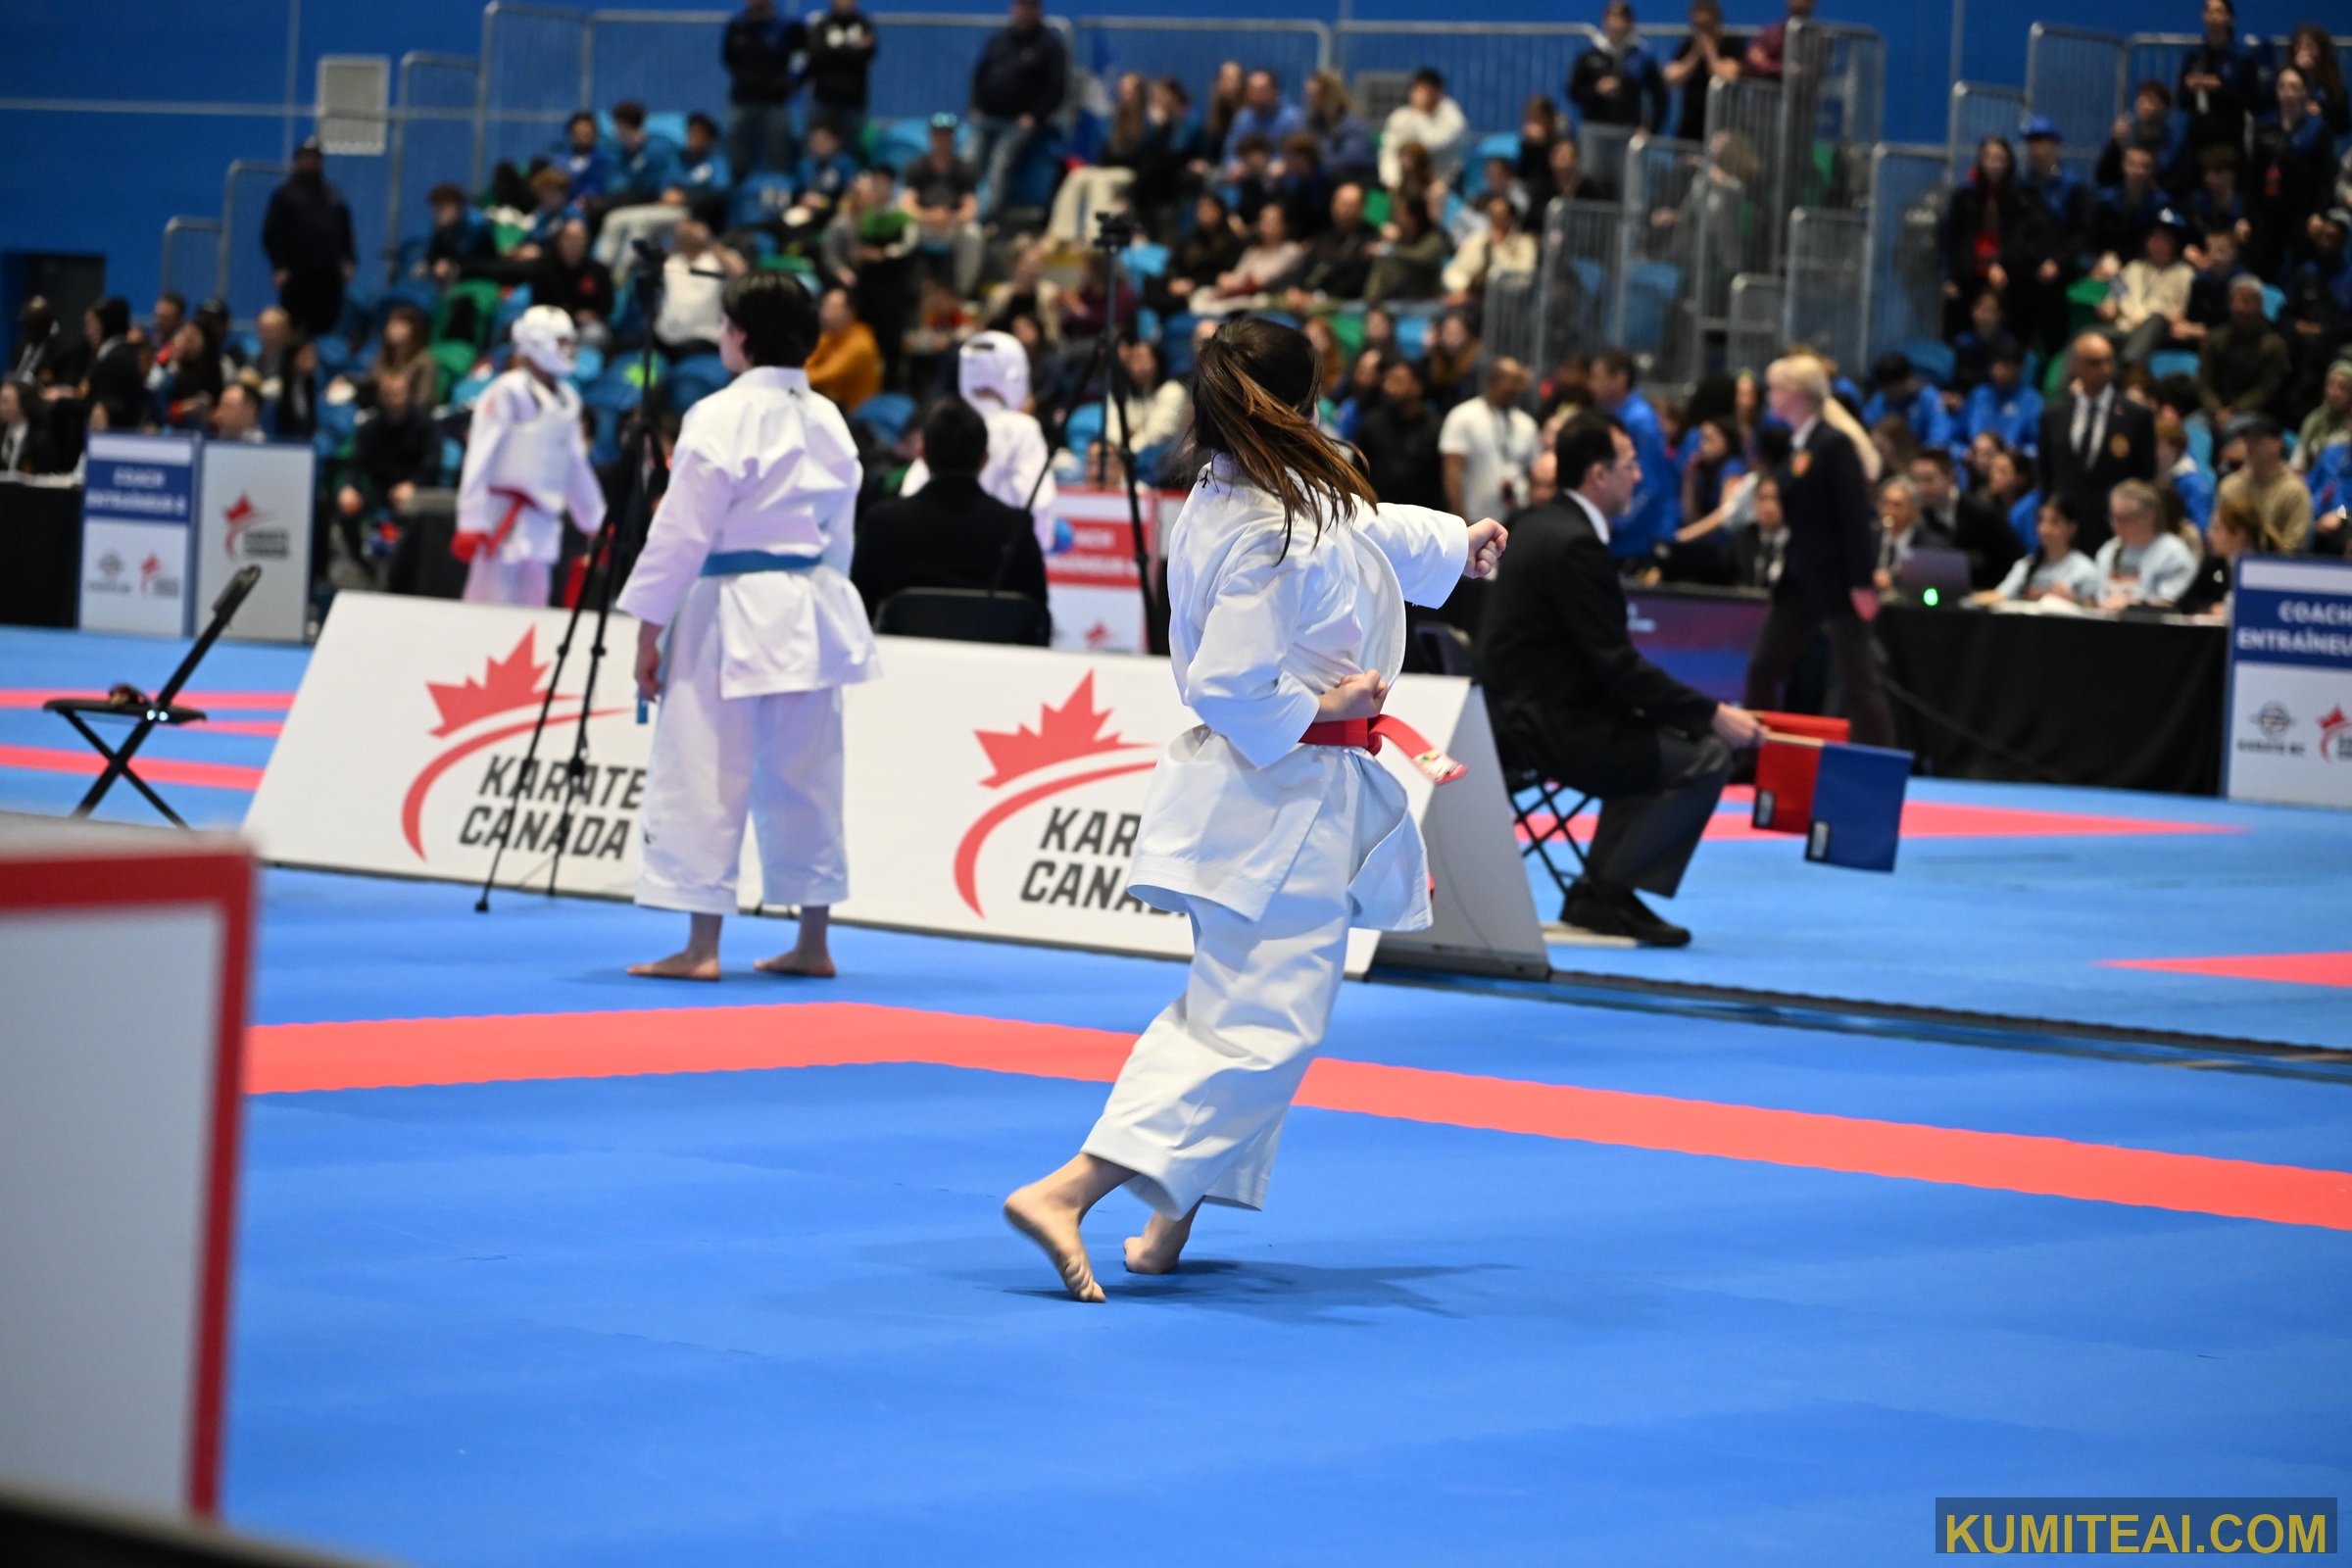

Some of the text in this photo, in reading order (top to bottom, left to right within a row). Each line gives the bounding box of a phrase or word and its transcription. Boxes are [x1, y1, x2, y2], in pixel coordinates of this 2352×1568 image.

[2278, 600, 2352, 626] COACH
[478, 756, 647, 810] KARATE
[459, 806, 631, 860] CANADA
[1039, 807, 1142, 858] KAR
